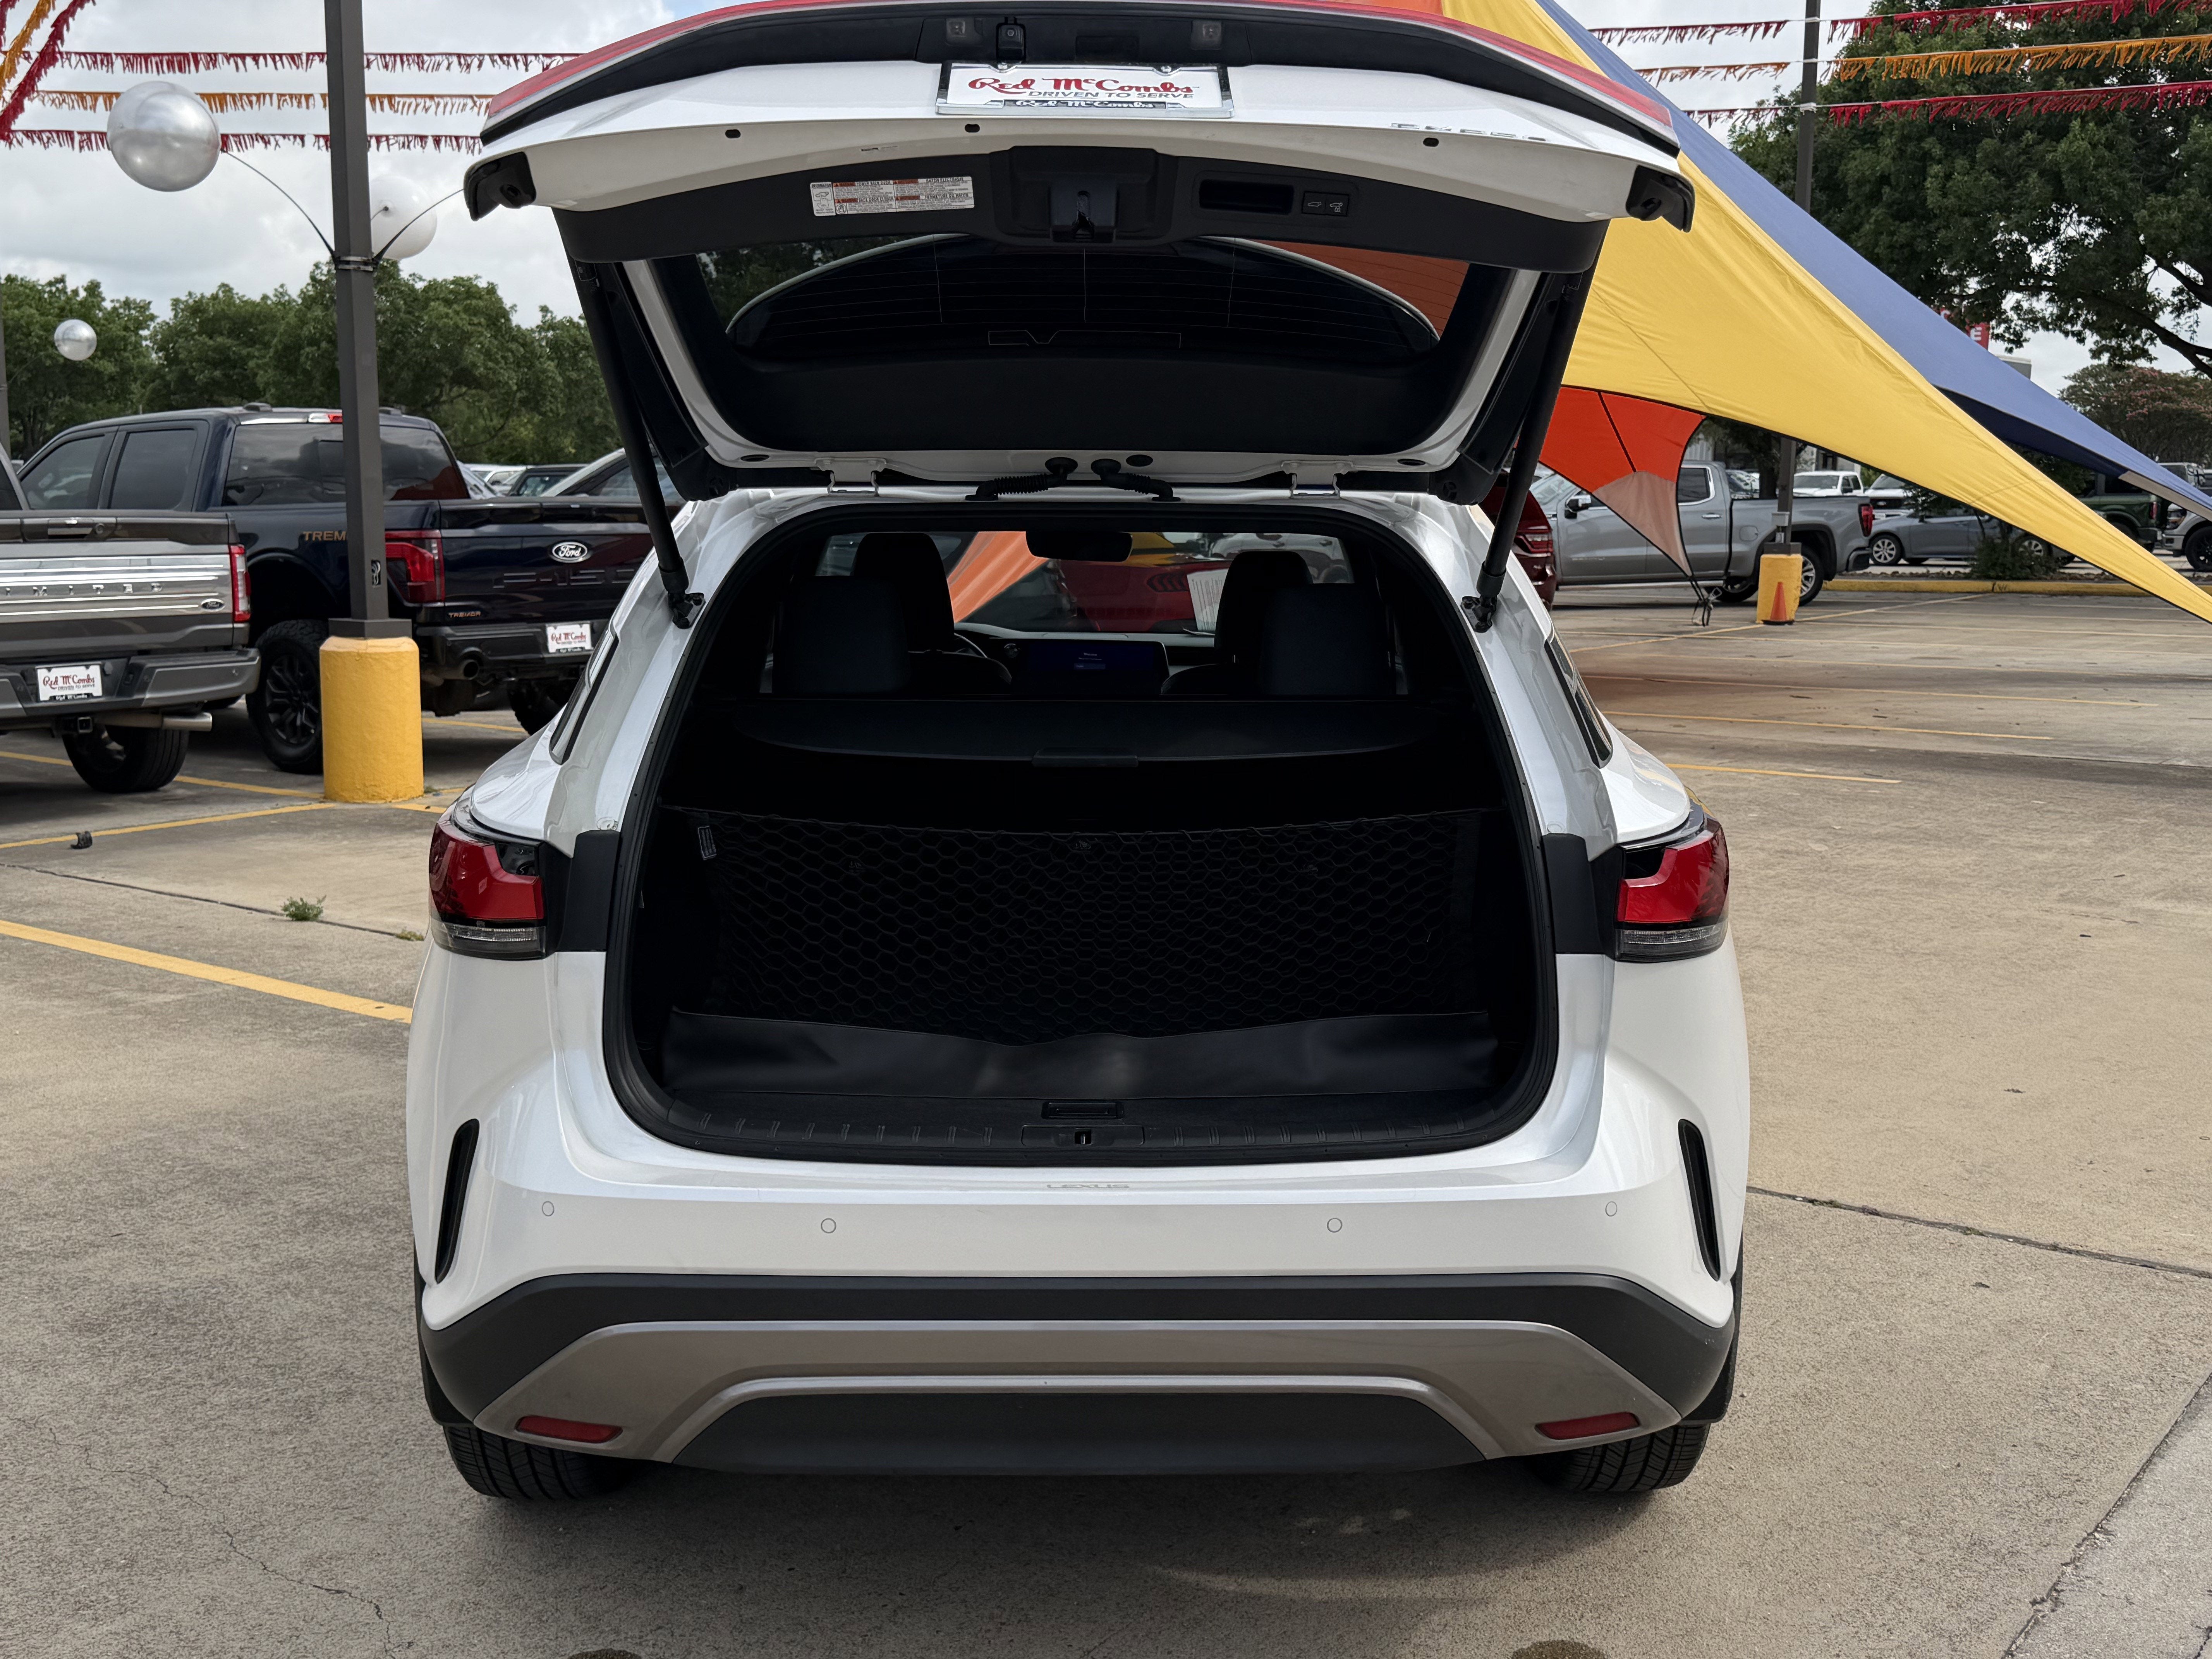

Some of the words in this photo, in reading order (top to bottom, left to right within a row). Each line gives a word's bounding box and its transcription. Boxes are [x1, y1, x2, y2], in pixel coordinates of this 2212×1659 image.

[968, 77, 1036, 94] Red
[1042, 78, 1193, 93] McCombs
[303, 531, 347, 541] TREM
[558, 545, 581, 557] Ford
[5, 583, 163, 596] IMITED
[43, 675, 58, 689] Red
[60, 674, 95, 685] McCombs
